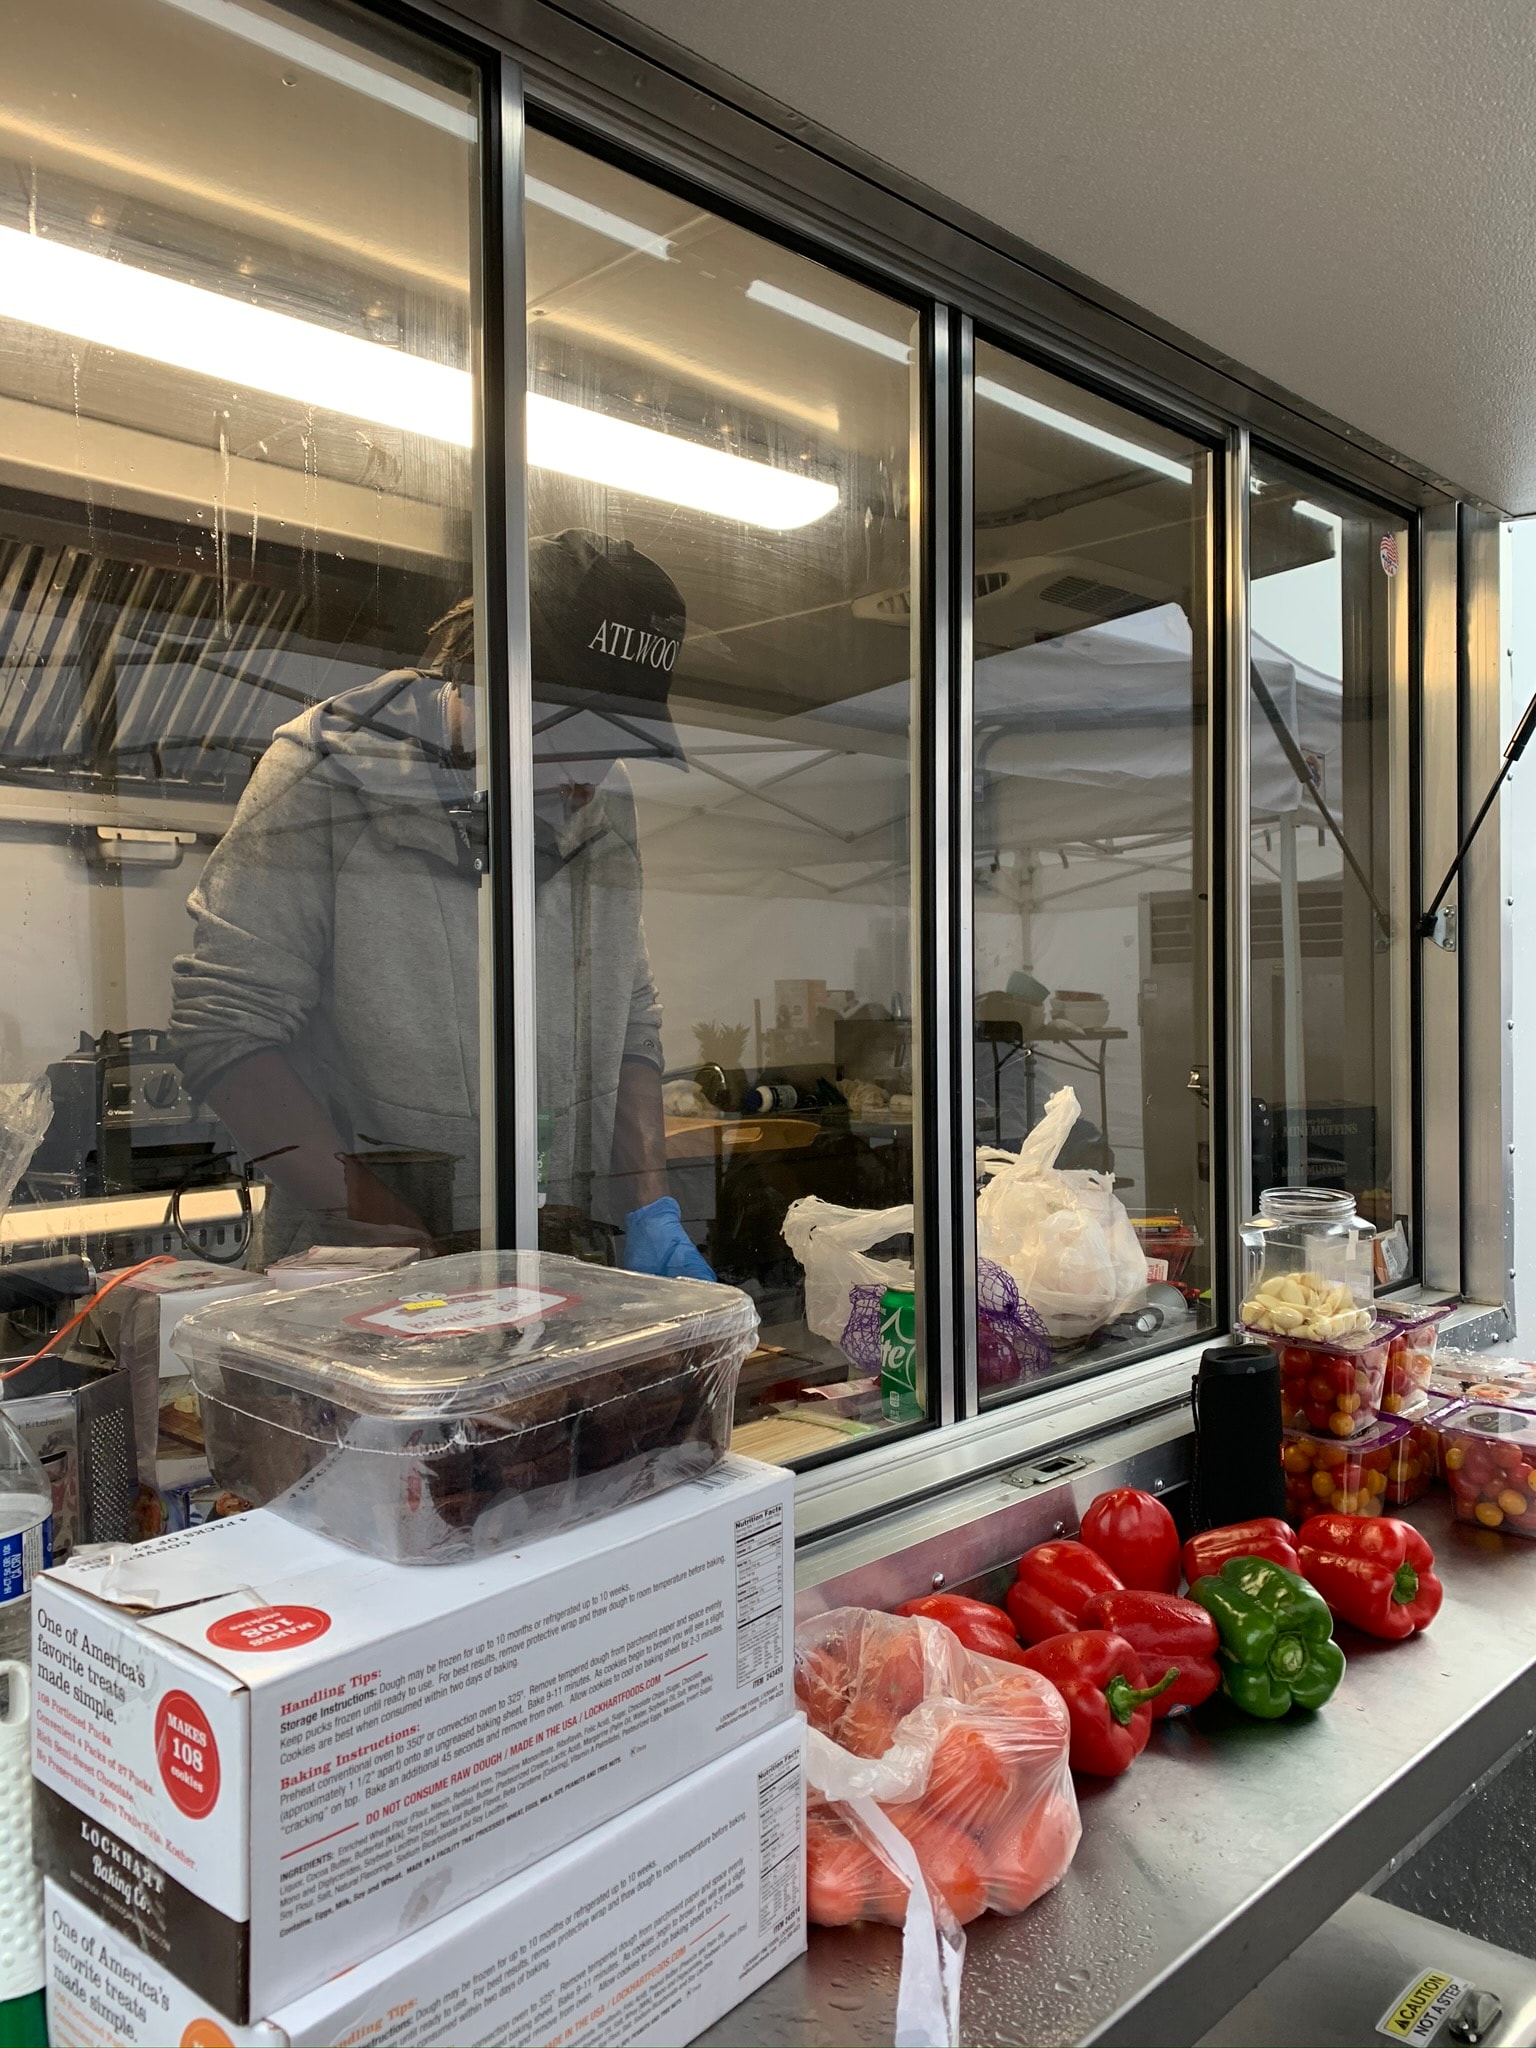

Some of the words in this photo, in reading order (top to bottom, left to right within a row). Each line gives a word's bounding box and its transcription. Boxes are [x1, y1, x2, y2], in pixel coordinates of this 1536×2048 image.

[588, 619, 679, 672] ATLWOO
[735, 1513, 763, 1529] Nutrition
[764, 1506, 781, 1517] Facts
[11, 1553, 21, 1568] CRV
[11, 1566, 22, 1579] CA
[37, 1608, 61, 1637] One
[64, 1627, 78, 1647] of
[241, 1618, 294, 1638] 108
[249, 1622, 316, 1646] MAKES
[37, 1634, 83, 1677] favorite
[87, 1666, 125, 1702] treats
[279, 1733, 302, 1749] Keep
[305, 1721, 332, 1741] pucks
[334, 1709, 360, 1727] frozen
[363, 1698, 381, 1715] until
[383, 1690, 405, 1706] ready
[407, 1686, 416, 1696] to
[417, 1679, 433, 1692] use.
[438, 1671, 451, 1683] For
[452, 1663, 468, 1677] best
[470, 1653, 497, 1670] results,
[498, 1640, 524, 1658] remove
[526, 1626, 558, 1648] protective
[560, 1618, 577, 1631] wrap
[578, 1611, 590, 1624] and
[591, 1606, 607, 1618] thaw
[608, 1596, 627, 1611] dough
[628, 1593, 635, 1602] to
[636, 1586, 651, 1599] room
[652, 1571, 687, 1592] temperature
[688, 1563, 705, 1577] before
[706, 1555, 725, 1568] baking.
[280, 1712, 317, 1733] Storage
[320, 1688, 377, 1717] Instructions:
[379, 1674, 405, 1693] Dough
[407, 1668, 424, 1681] may
[426, 1663, 436, 1674] be
[437, 1652, 461, 1669] frozen
[463, 1647, 473, 1658] for
[475, 1643, 485, 1654] up
[486, 1639, 494, 1649] to
[495, 1633, 505, 1645] 10
[506, 1623, 532, 1640] months
[533, 1619, 540, 1629] or
[542, 1602, 580, 1625] refrigerated
[581, 1599, 590, 1609] up
[591, 1596, 598, 1605] to
[599, 1590, 608, 1601] 10
[608, 1583, 630, 1597] weeks.
[37, 1663, 69, 1694] made
[73, 1685, 116, 1724] simple.
[279, 1781, 315, 1805] Preheat
[317, 1756, 371, 1789] conventional
[373, 1749, 393, 1764] oven
[395, 1744, 404, 1755] to
[426, 1730, 435, 1741] or
[436, 1712, 477, 1736] convection
[478, 1703, 496, 1718] oven
[498, 1699, 505, 1709] to
[529, 1676, 556, 1695] Remove
[557, 1660, 588, 1681] tempered
[589, 1651, 609, 1667] dough
[610, 1644, 625, 1657] from
[626, 1628, 657, 1652] parchment
[658, 1621, 675, 1637] paper
[676, 1614, 687, 1627] and
[687, 1608, 704, 1622] space
[704, 1599, 721, 1613] evenly
[279, 1743, 315, 1765] Cookies
[317, 1736, 332, 1749] are
[334, 1725, 353, 1742] best
[355, 1717, 378, 1733] when
[380, 1696, 422, 1723] consumed
[423, 1687, 447, 1704] within
[449, 1680, 463, 1693] two
[464, 1672, 482, 1686] days
[484, 1666, 492, 1678] of
[493, 1658, 517, 1675] baking.
[280, 1683, 345, 1716] Handling
[349, 1669, 381, 1688] Tips:
[167, 1712, 206, 1747] MAKES
[366, 1809, 379, 1825] DO
[382, 1799, 401, 1817] NOT
[403, 1777, 448, 1806] CONSUME
[450, 1766, 471, 1785] RAW
[473, 1751, 502, 1774] DOUGH
[509, 1736, 533, 1756] MADE
[535, 1731, 543, 1744] IN
[545, 1723, 560, 1738] THE
[561, 1715, 577, 1730] USA
[584, 1674, 660, 1719] LOCKHARTFOODS.COM
[172, 1737, 203, 1772] 108
[280, 1761, 331, 1790] Baking
[336, 1724, 419, 1766] Instructions:
[170, 1765, 203, 1792] cookies
[81, 1821, 163, 1892] LOCKHART
[92, 1854, 131, 1904] Baking
[133, 1885, 150, 1914] Co.
[52, 1909, 77, 1943] One
[80, 1936, 95, 1956] of
[53, 1935, 100, 1988] favorite
[105, 1977, 146, 2022] treats
[611, 1945, 685, 2005] LOCKHARTFOODS.COM
[1399, 1975, 1446, 2020] CAUTION
[1436, 1983, 1462, 2007] STEP
[54, 1965, 86, 2002] made
[89, 1995, 137, 2043] simple.
[1413, 2012, 1439, 2037] NOT
[1435, 2006, 1446, 2015] A
